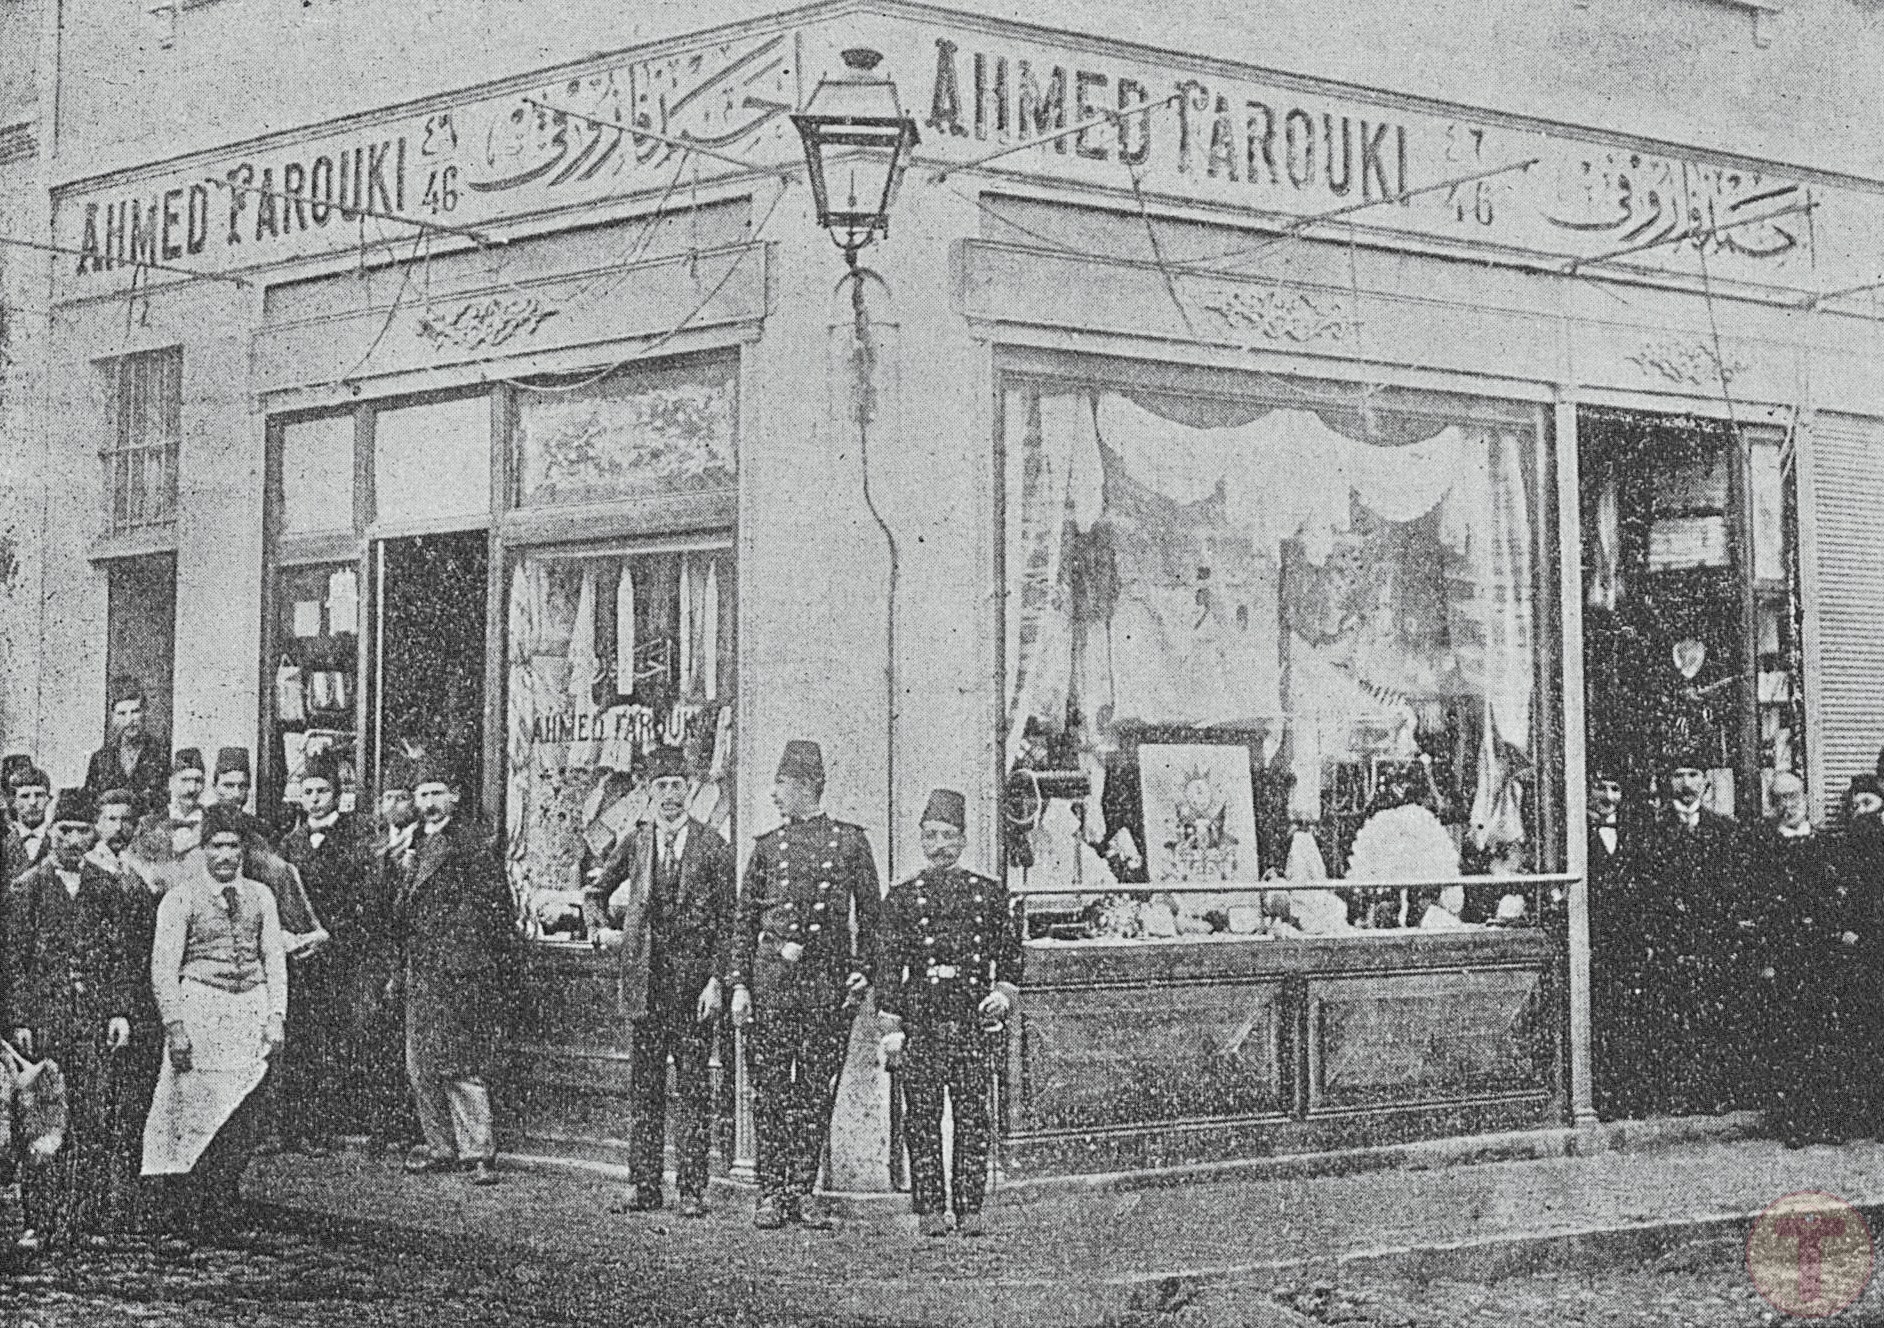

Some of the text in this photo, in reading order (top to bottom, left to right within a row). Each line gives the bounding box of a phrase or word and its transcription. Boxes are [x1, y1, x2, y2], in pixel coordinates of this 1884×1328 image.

[926, 36, 1410, 206] AHMED FAROUKI
[77, 136, 406, 277] AHMED FAROUKI
[421, 164, 458, 215] 46
[530, 711, 604, 745] AHMED
